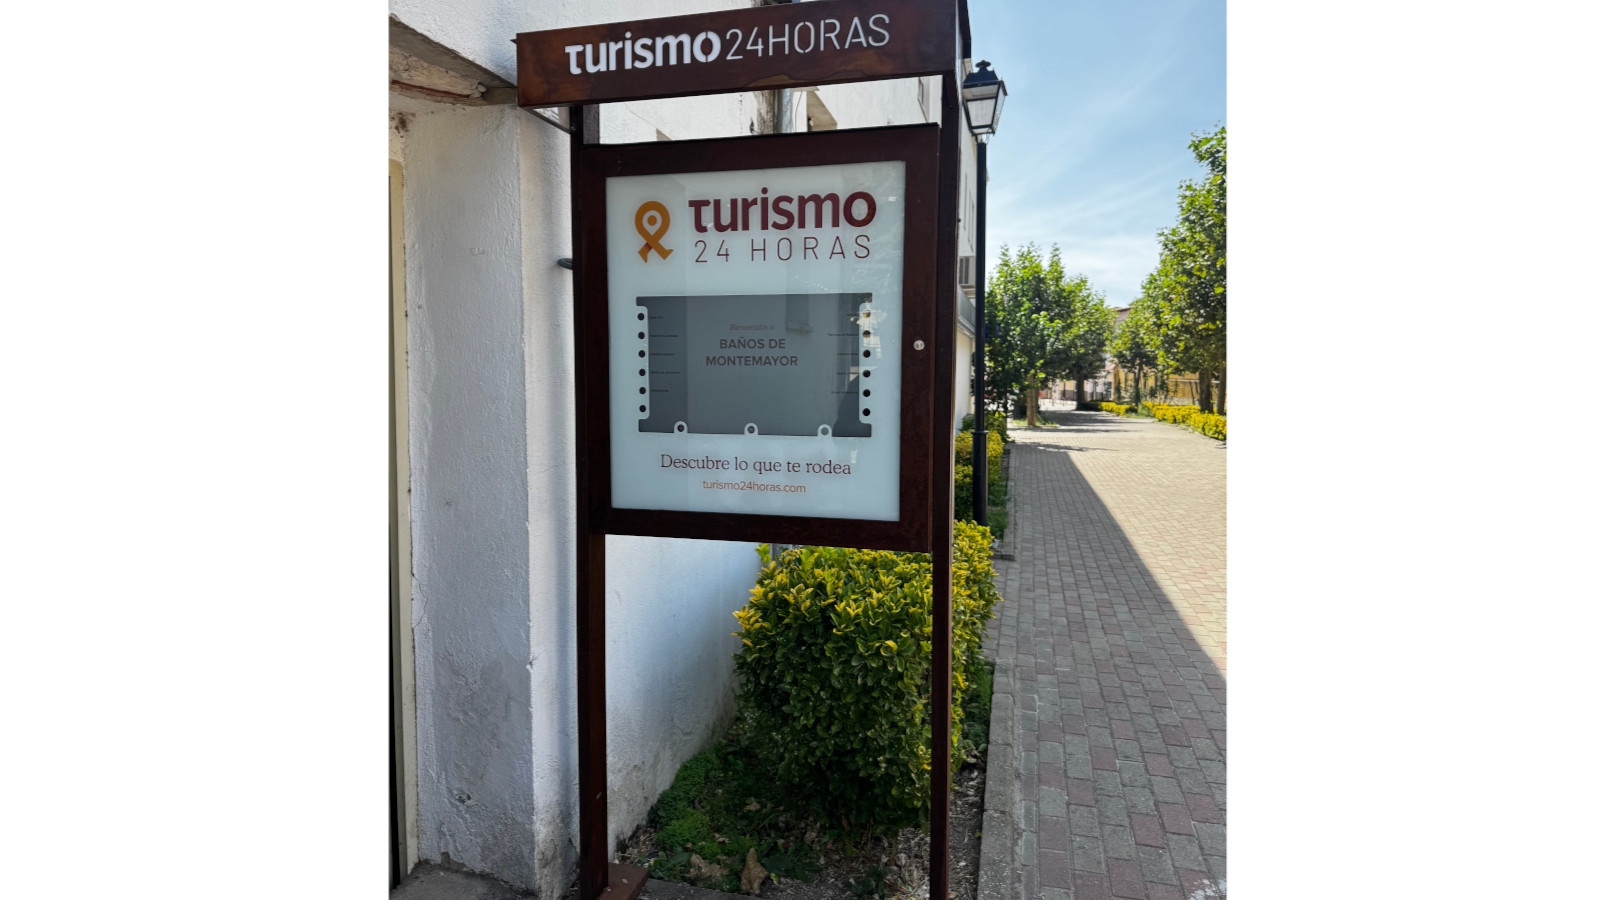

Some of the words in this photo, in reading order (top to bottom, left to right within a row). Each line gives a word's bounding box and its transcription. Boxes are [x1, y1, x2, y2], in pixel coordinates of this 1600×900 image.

[694, 239, 730, 263] 24
[751, 234, 871, 262] HORAS
[719, 336, 765, 349] BAÑOS
[768, 338, 786, 349] DE
[705, 355, 799, 367] MONTEMAYOR
[660, 453, 730, 471] Descubre
[734, 456, 749, 471] lo
[753, 460, 782, 475] que
[786, 460, 801, 473] te
[805, 460, 852, 475] rodea
[702, 479, 806, 494] turismo24horas.com
